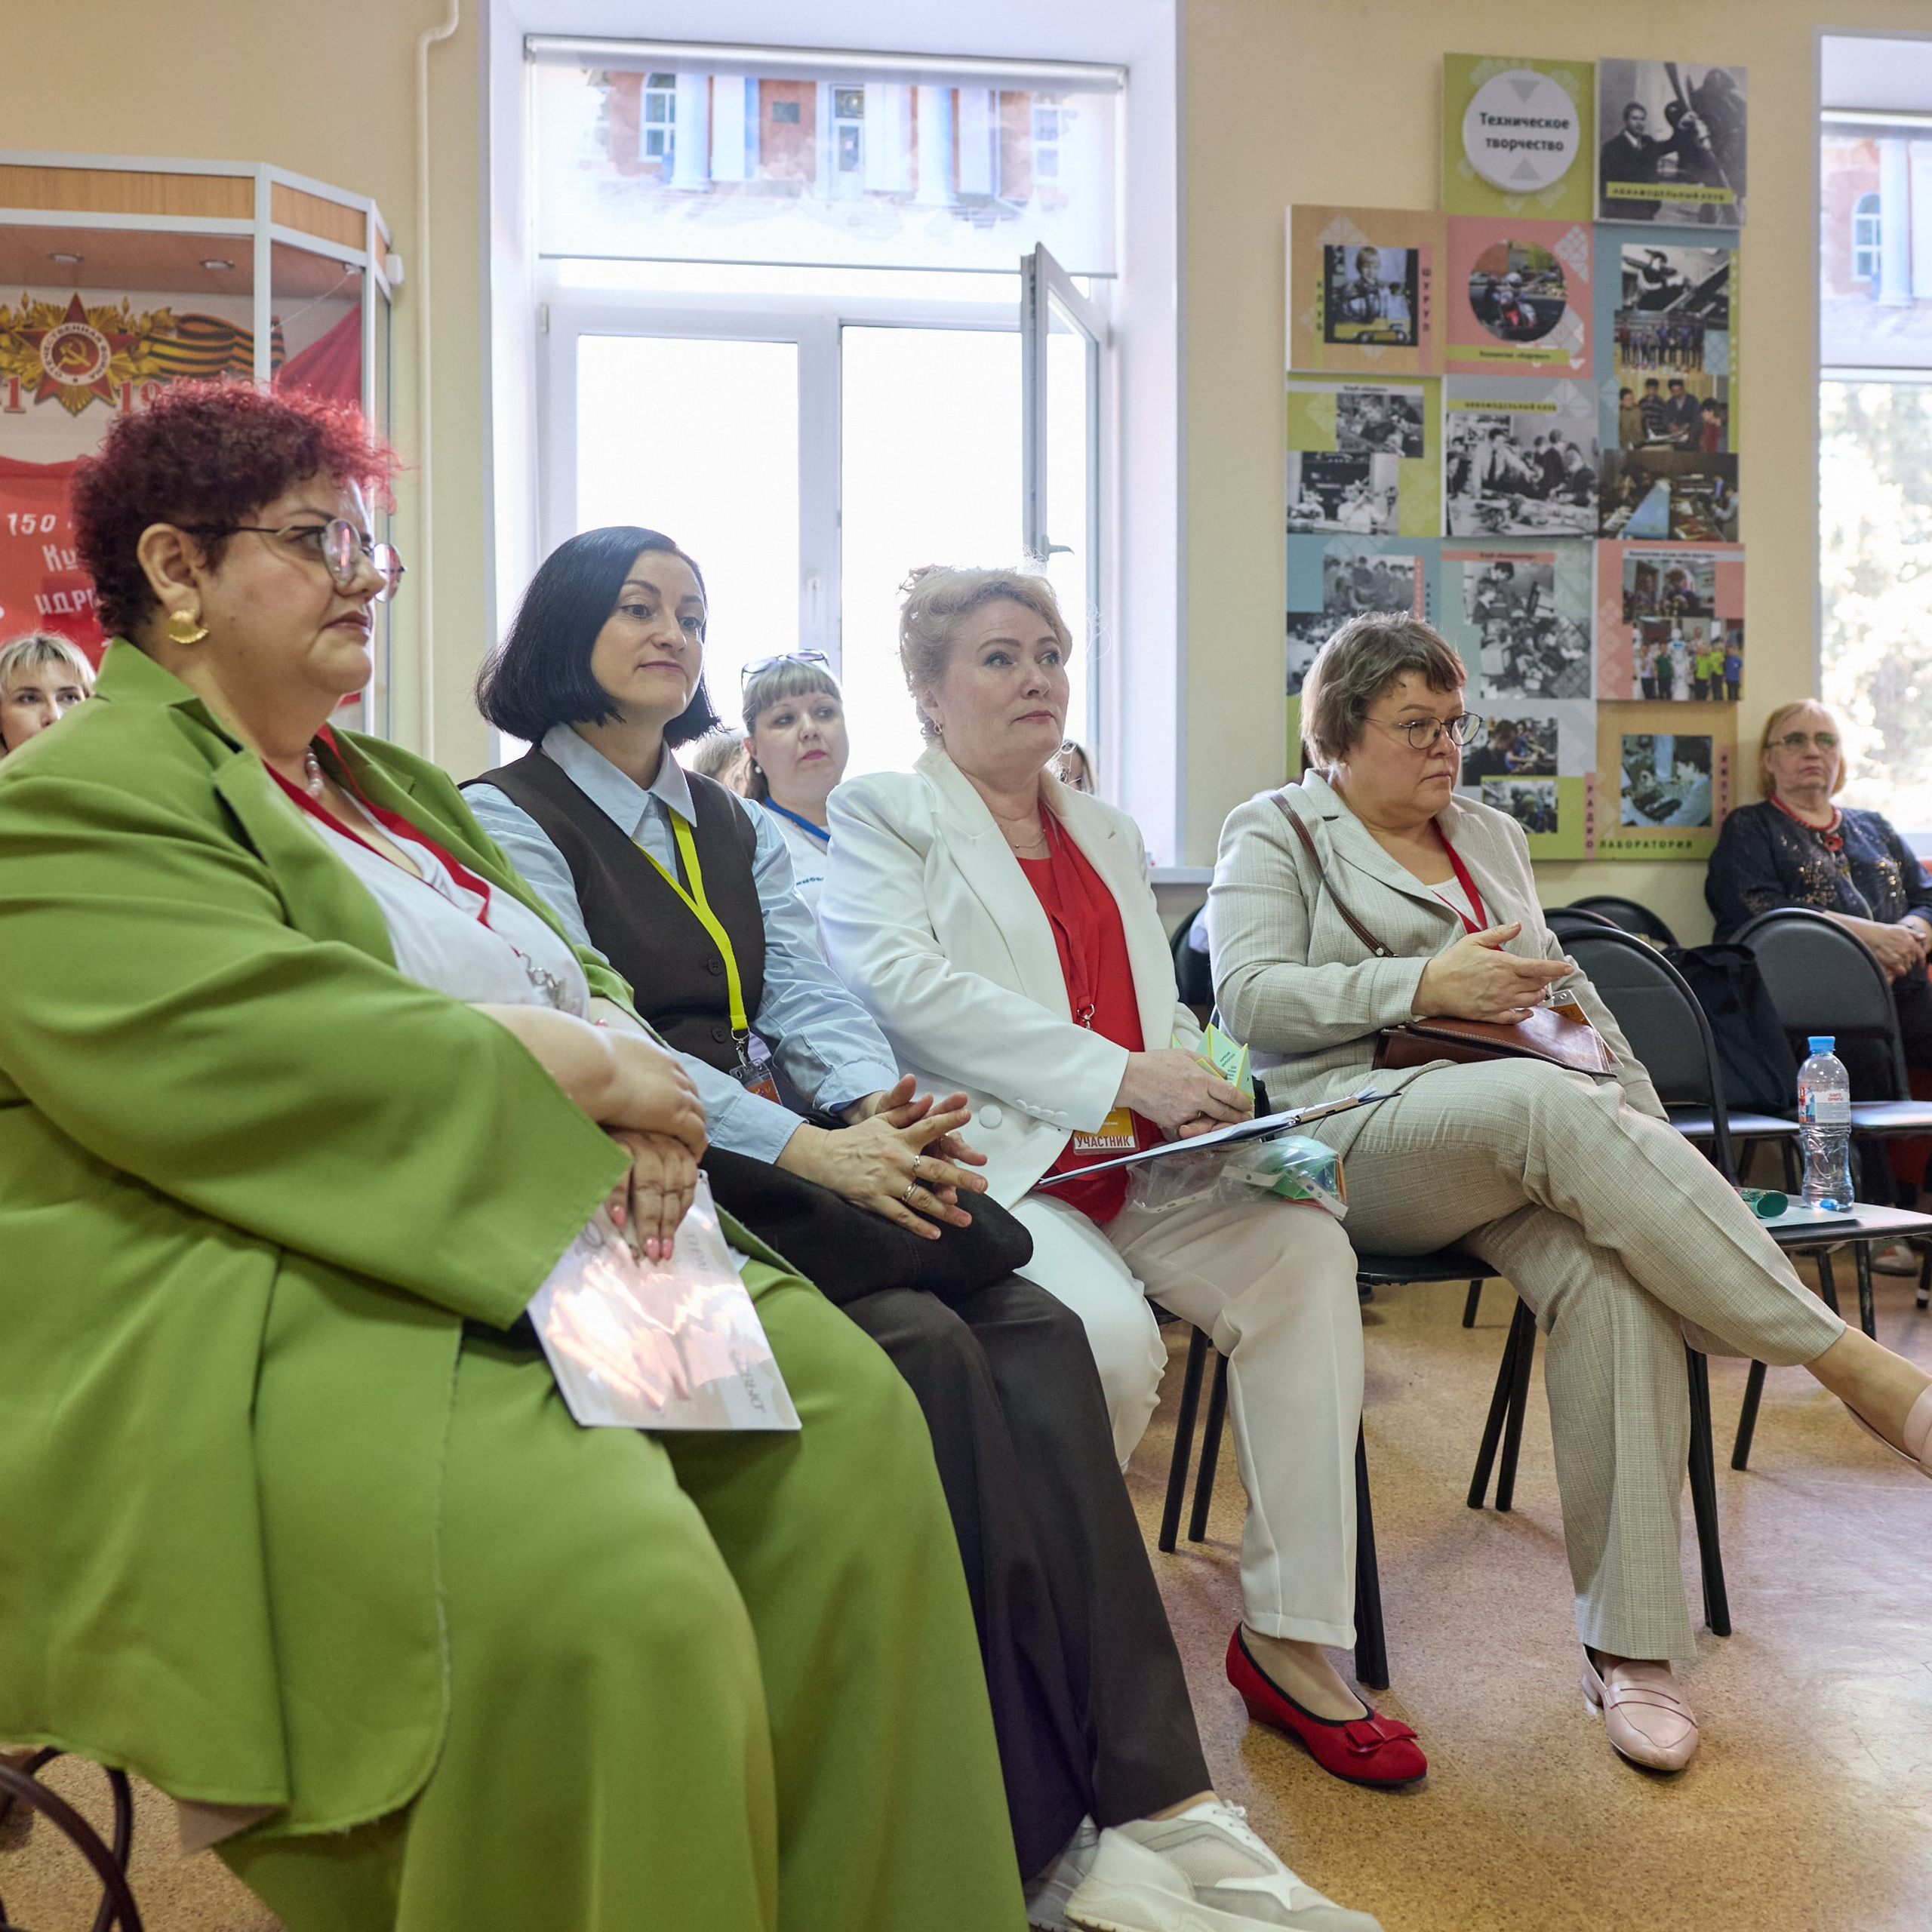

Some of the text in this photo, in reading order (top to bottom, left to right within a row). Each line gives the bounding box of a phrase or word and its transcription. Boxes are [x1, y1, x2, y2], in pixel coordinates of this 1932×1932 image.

[1480, 112, 1570, 129] Техническое
[1486, 137, 1564, 152] творчество
[1422, 268, 1432, 332] ШУРУП
[8, 512, 57, 537] 150
[1599, 839, 1692, 849] ЛАБОРАТОРИЯ
[1077, 1136, 1131, 1148] УЧАСТНИК
